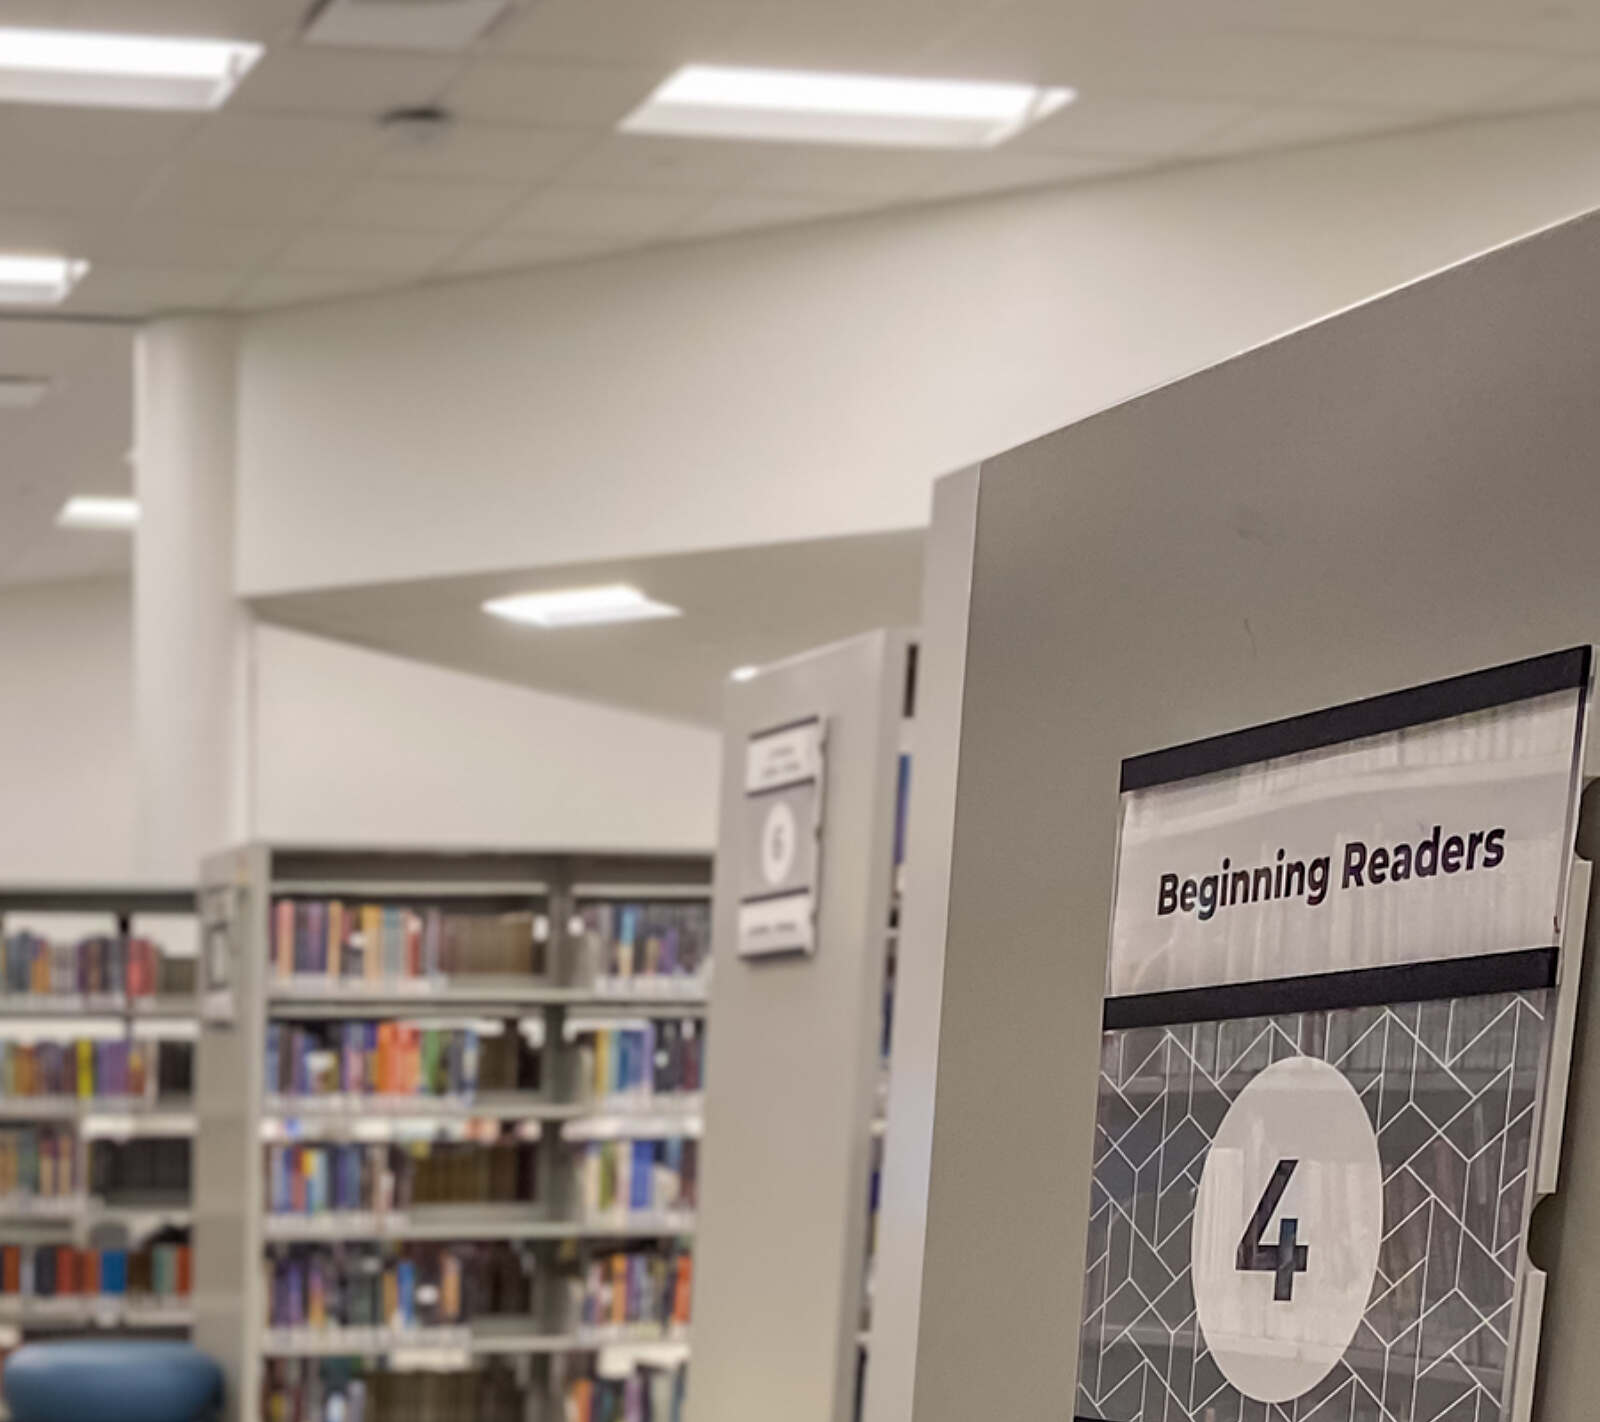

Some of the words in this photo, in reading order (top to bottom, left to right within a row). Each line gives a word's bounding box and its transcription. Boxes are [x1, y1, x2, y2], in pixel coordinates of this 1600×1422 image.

[1157, 848, 1330, 921] Beginning
[1341, 825, 1506, 889] Readers
[1235, 1159, 1309, 1301] 4
